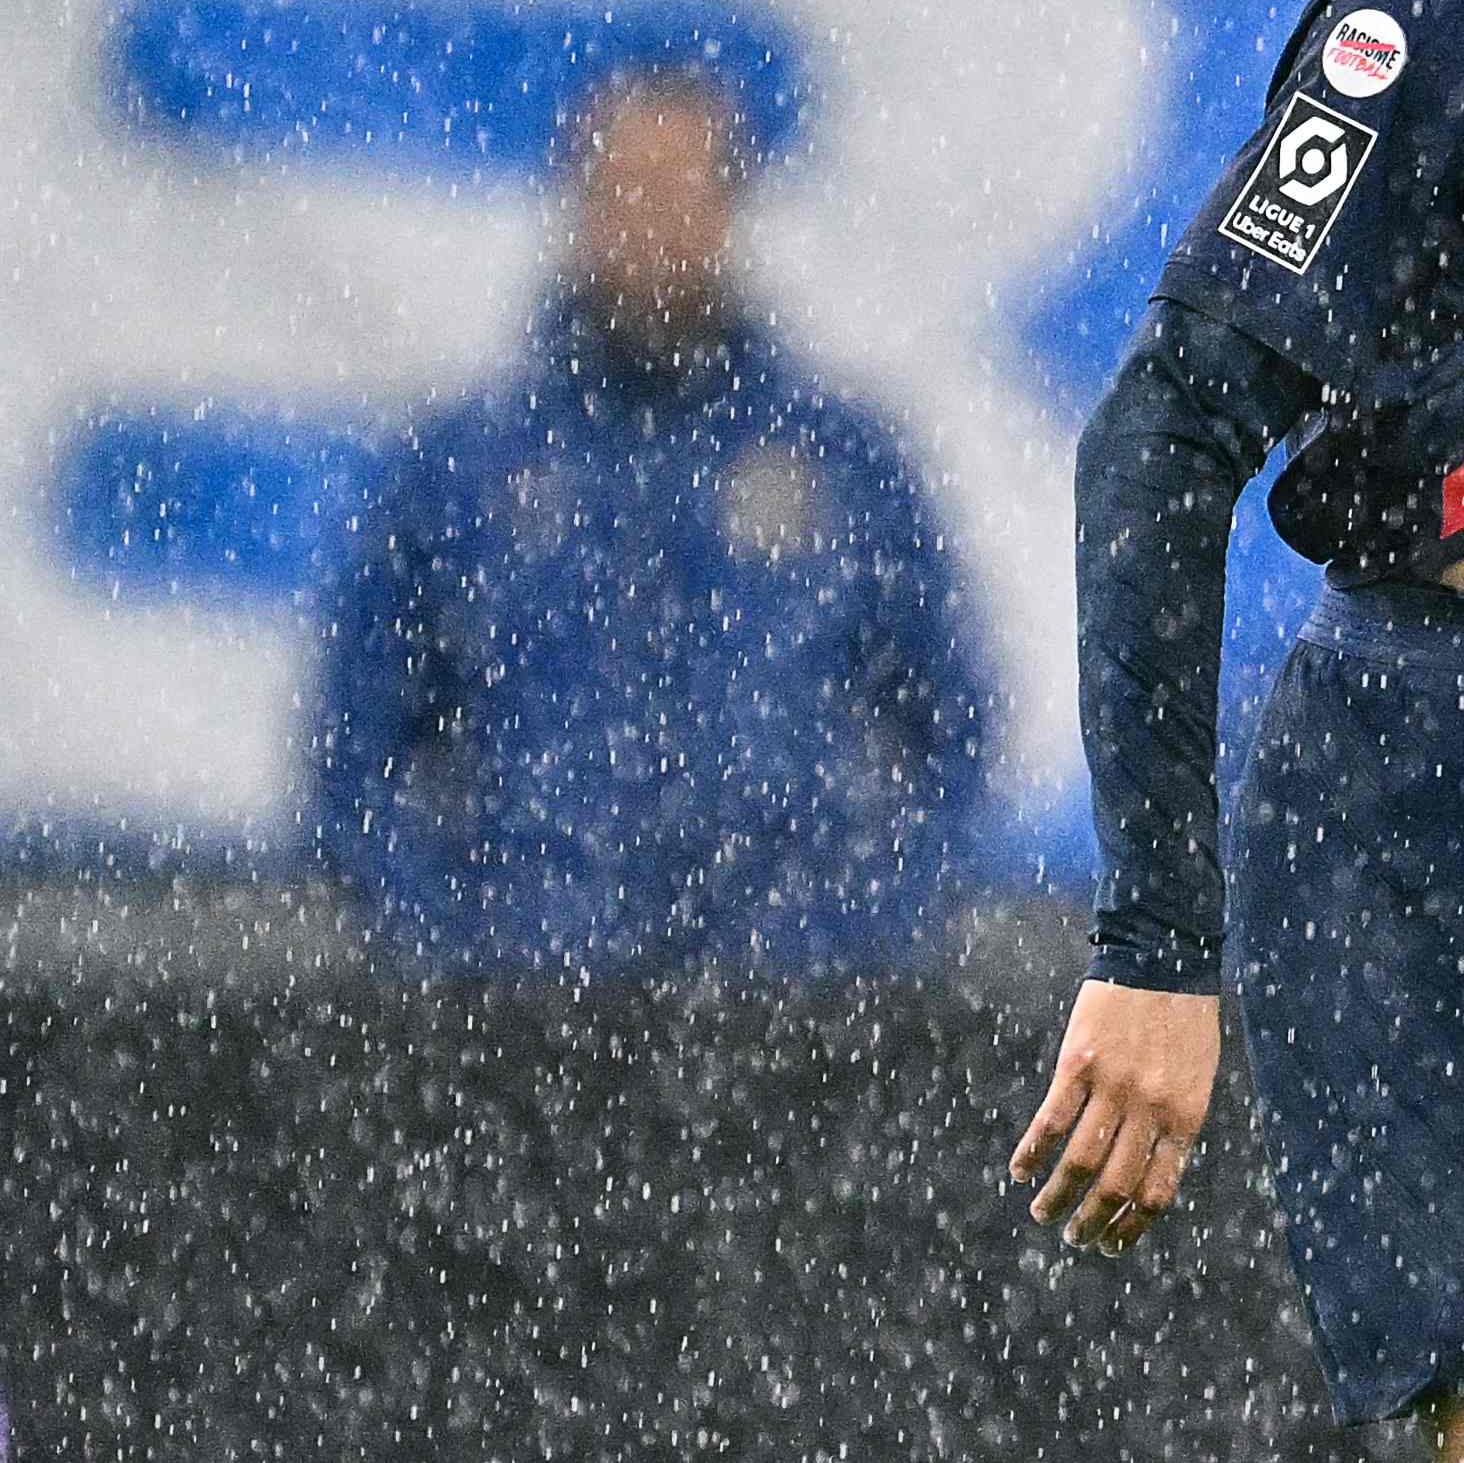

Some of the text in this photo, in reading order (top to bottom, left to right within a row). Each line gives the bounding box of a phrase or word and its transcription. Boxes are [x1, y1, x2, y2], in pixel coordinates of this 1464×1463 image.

[1336, 23, 1400, 70] RACISME
[1232, 212, 1307, 262] Uber Eats
[1249, 195, 1316, 239] LIGUE 1
